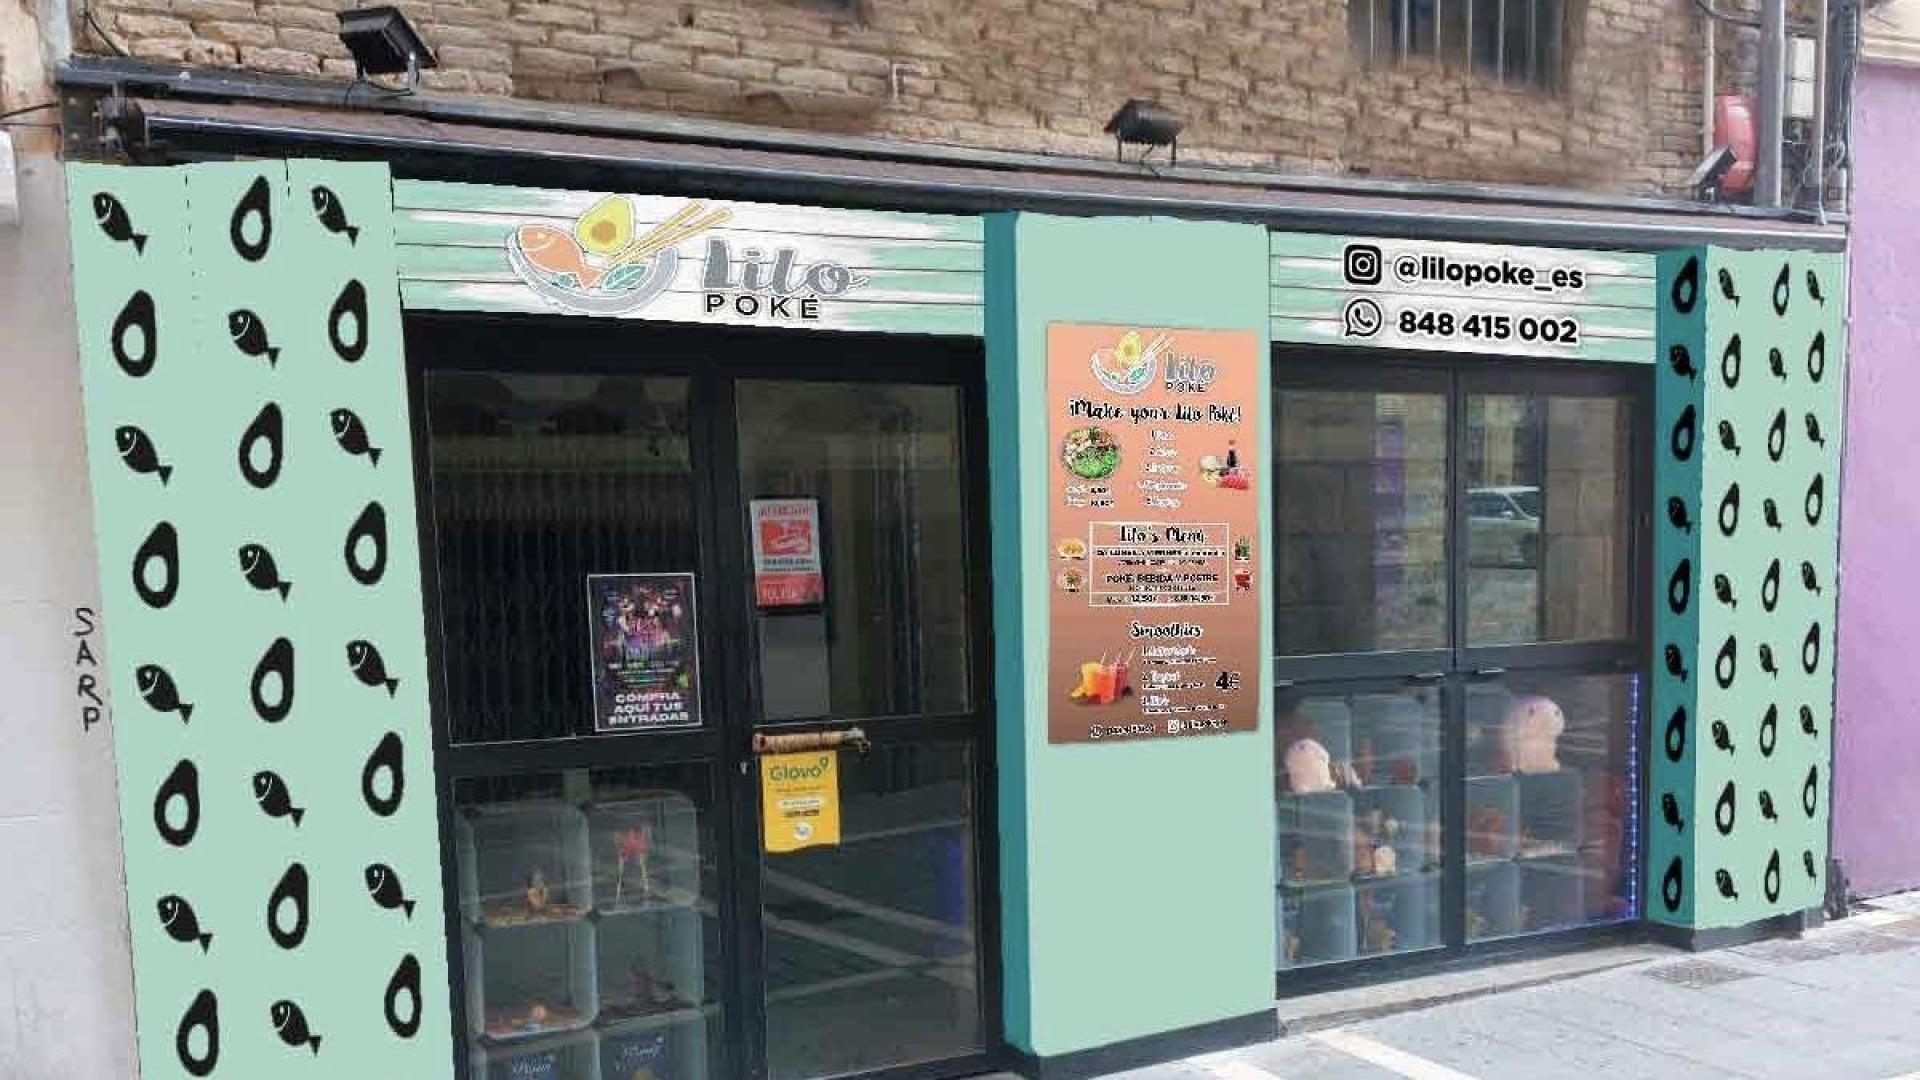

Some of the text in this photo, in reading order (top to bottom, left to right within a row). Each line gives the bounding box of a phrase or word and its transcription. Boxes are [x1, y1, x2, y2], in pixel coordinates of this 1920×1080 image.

[704, 237, 869, 295] Lilo
[1394, 255, 1583, 292] @lilopoke_es
[706, 294, 819, 319] POKÉ
[1399, 311, 1577, 342] 848 415 002
[73, 607, 103, 733] SARP
[615, 692, 680, 704] COMPRA
[608, 711, 689, 725] ENTRADAS
[769, 763, 822, 782] Glovo
